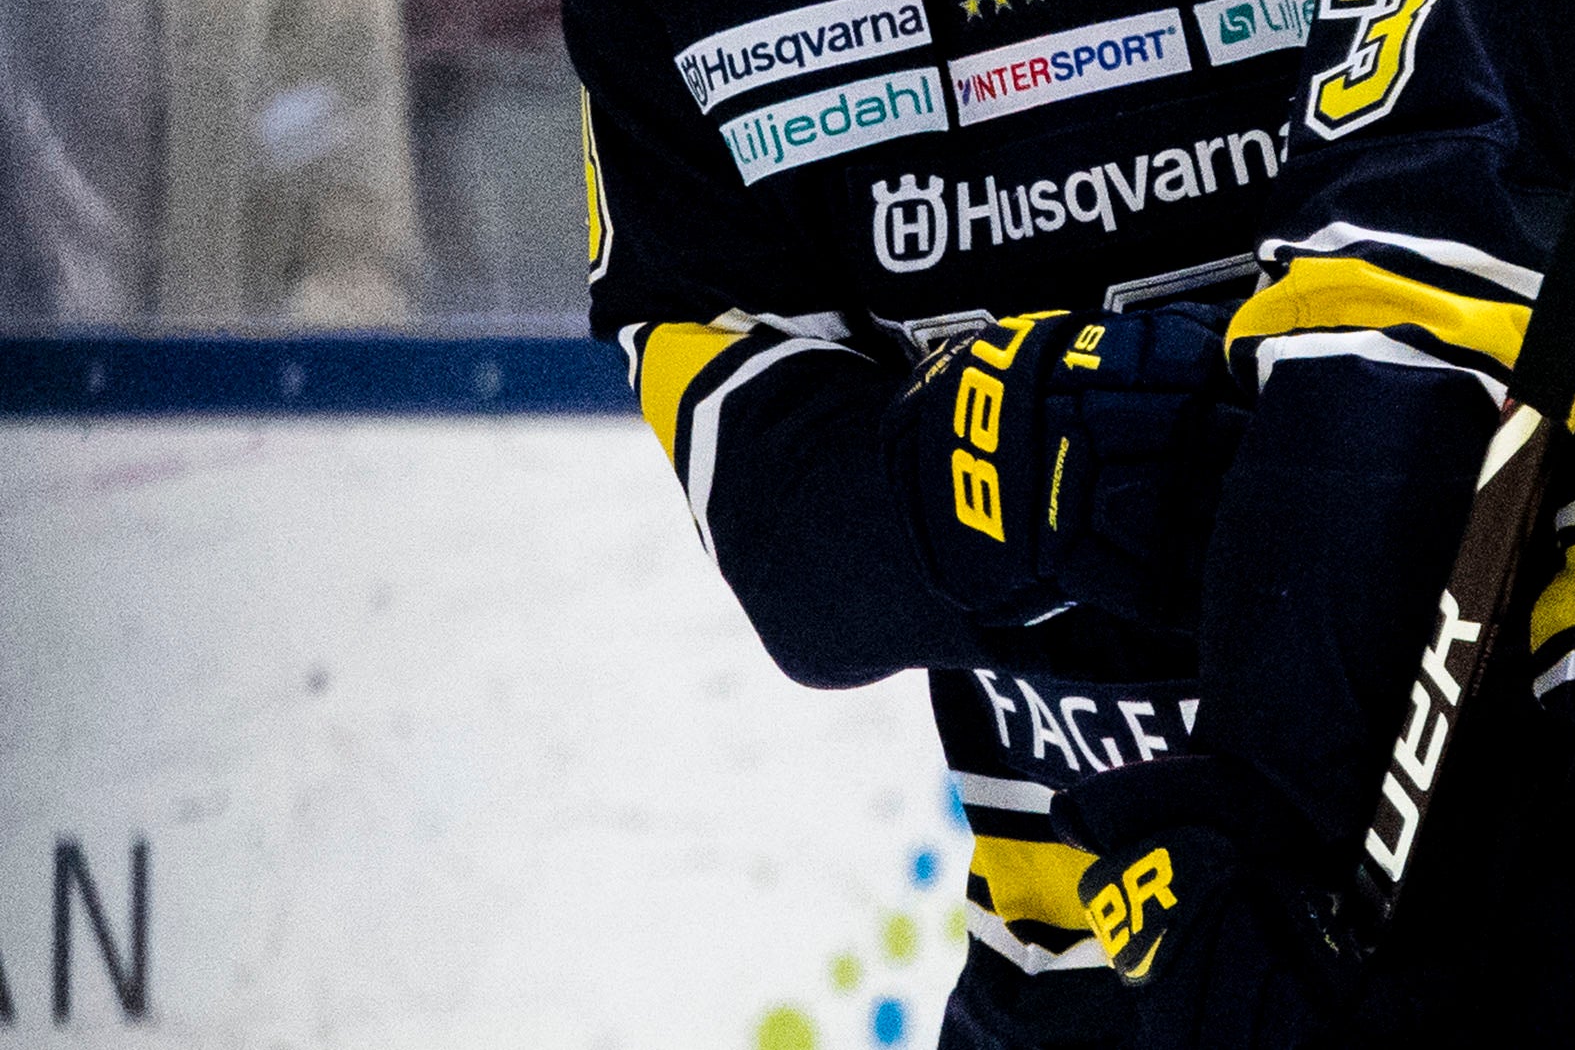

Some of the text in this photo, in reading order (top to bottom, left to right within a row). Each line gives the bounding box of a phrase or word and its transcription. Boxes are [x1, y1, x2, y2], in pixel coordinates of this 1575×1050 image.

[702, 4, 925, 92] Husqvarna
[970, 28, 1168, 103] INTERSPORT
[731, 75, 935, 165] Liljedahl
[951, 310, 1072, 543] BAU
[1084, 847, 1179, 962] ER
